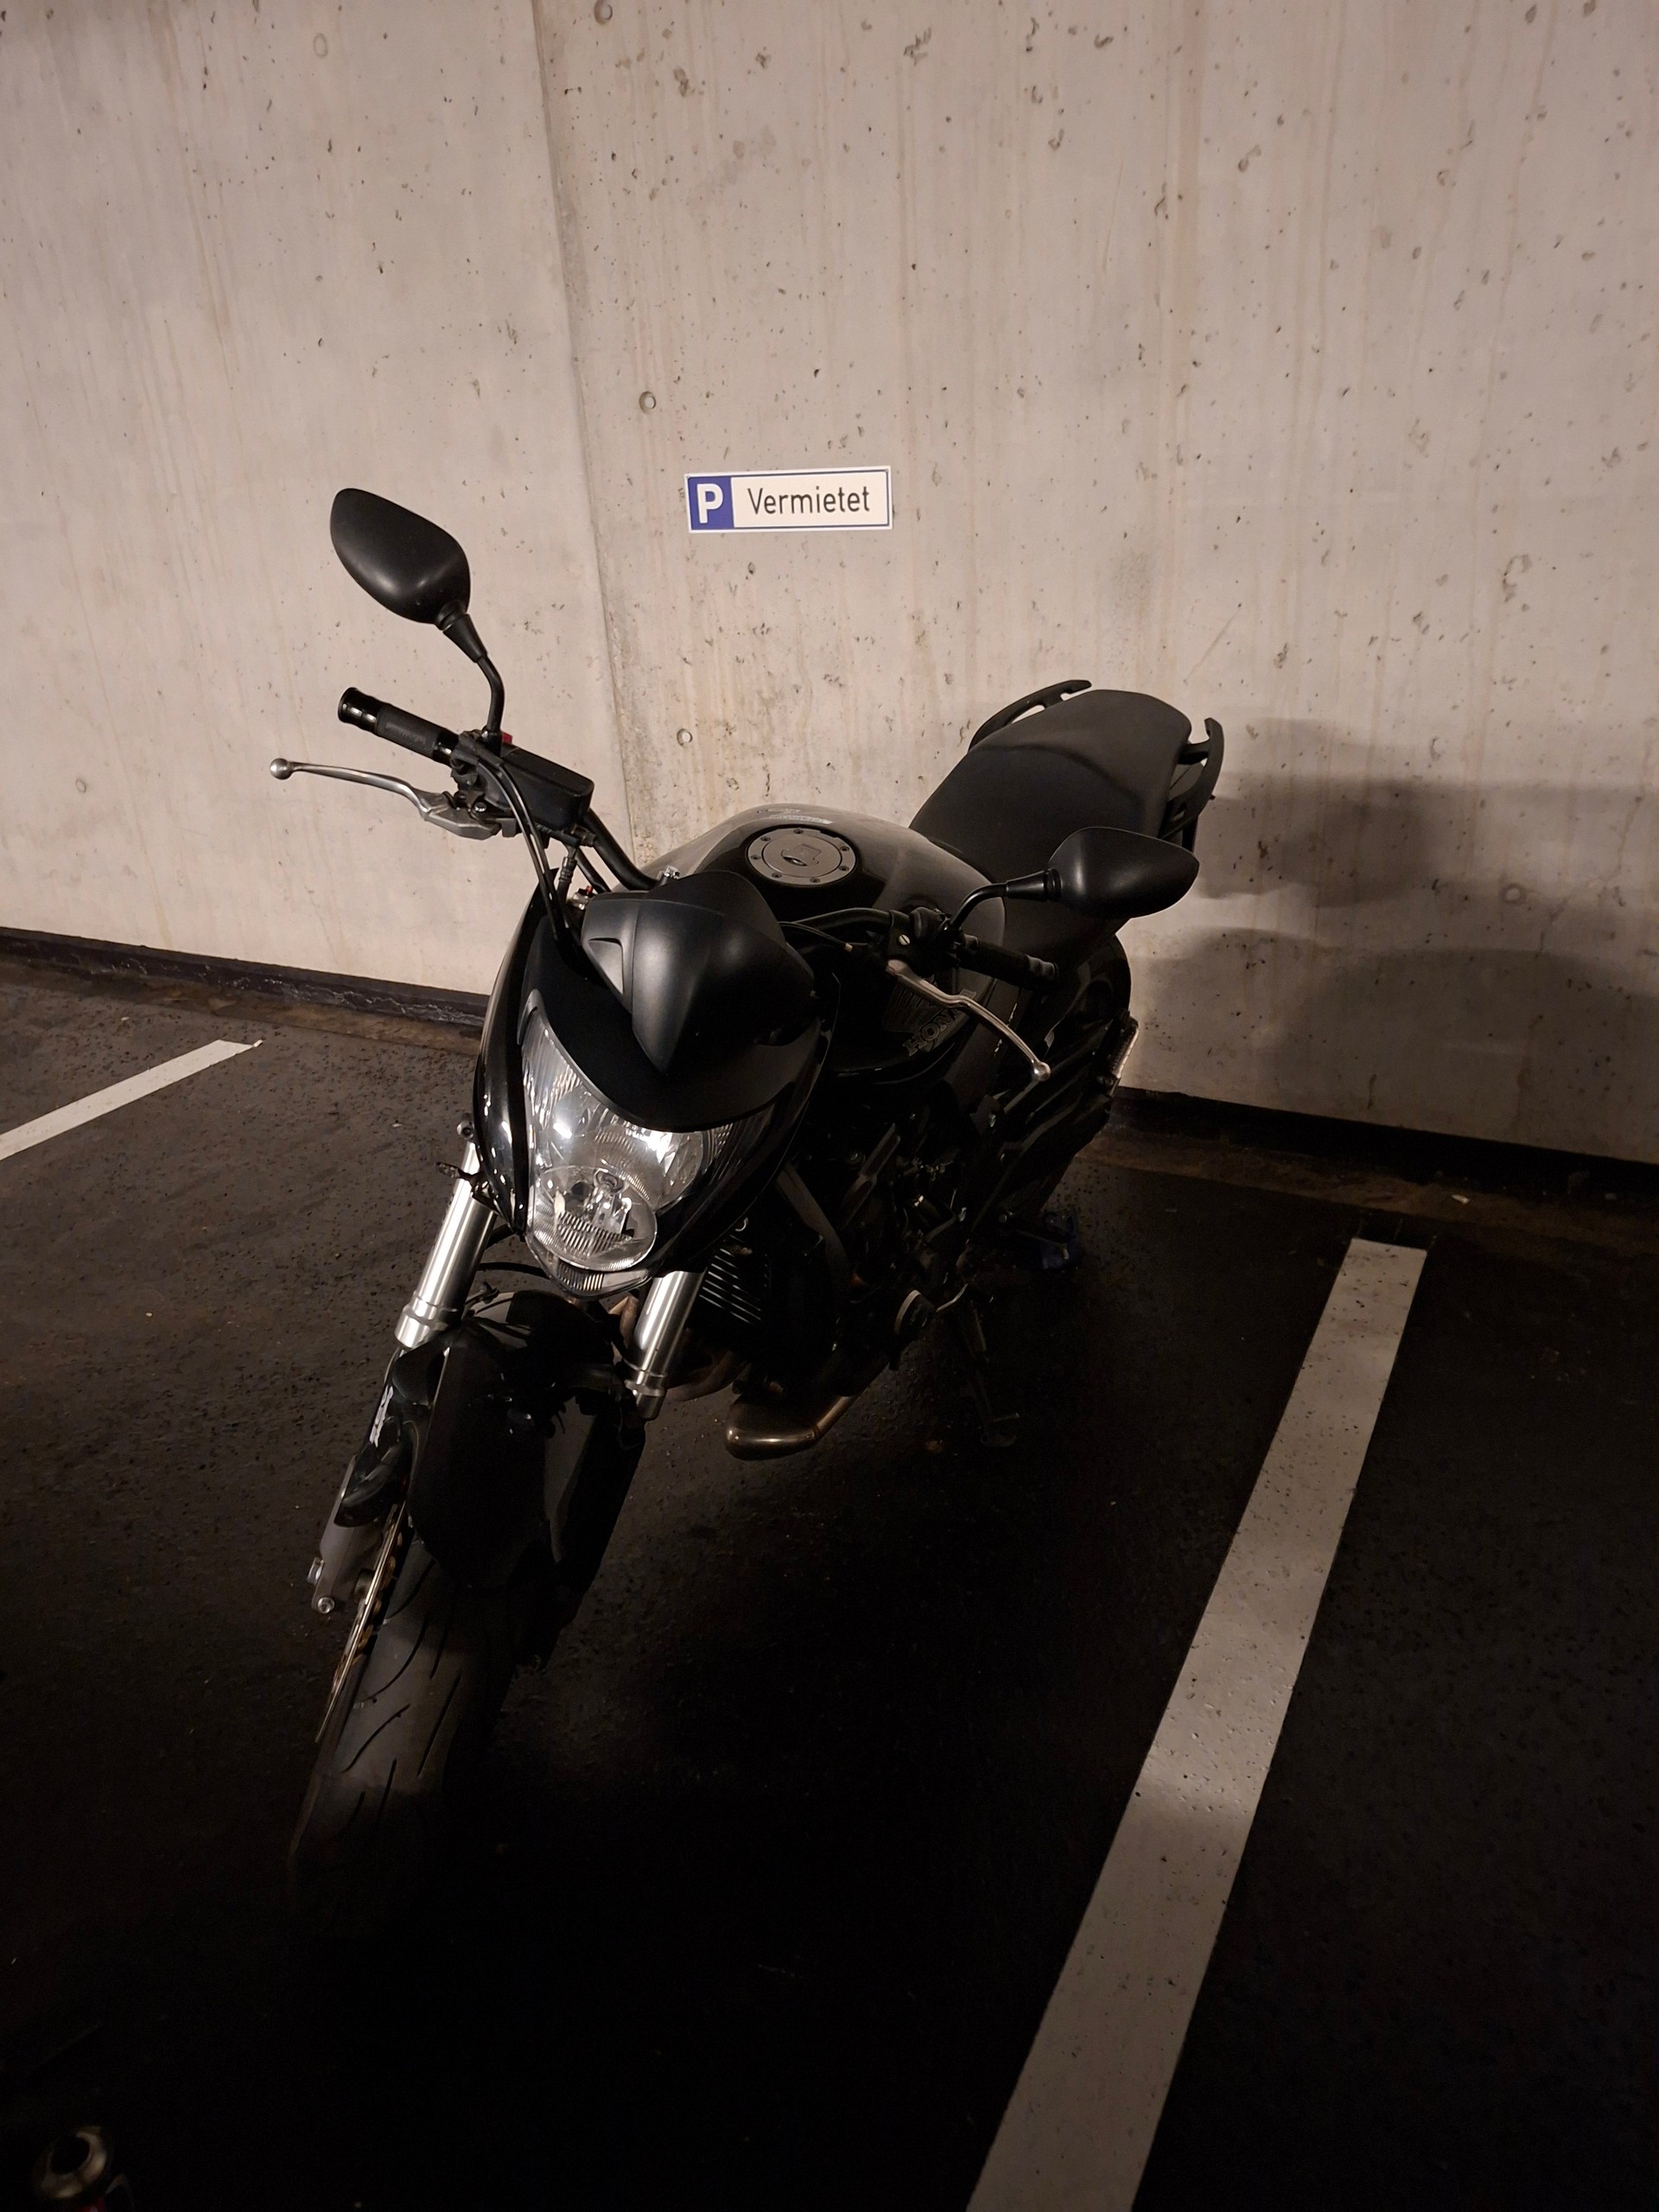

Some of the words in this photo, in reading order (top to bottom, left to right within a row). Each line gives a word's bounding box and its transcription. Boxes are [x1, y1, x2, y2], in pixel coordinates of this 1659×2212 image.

[696, 483, 723, 524] P
[747, 486, 870, 515] Vermietet
[901, 1003, 958, 1058] HON
